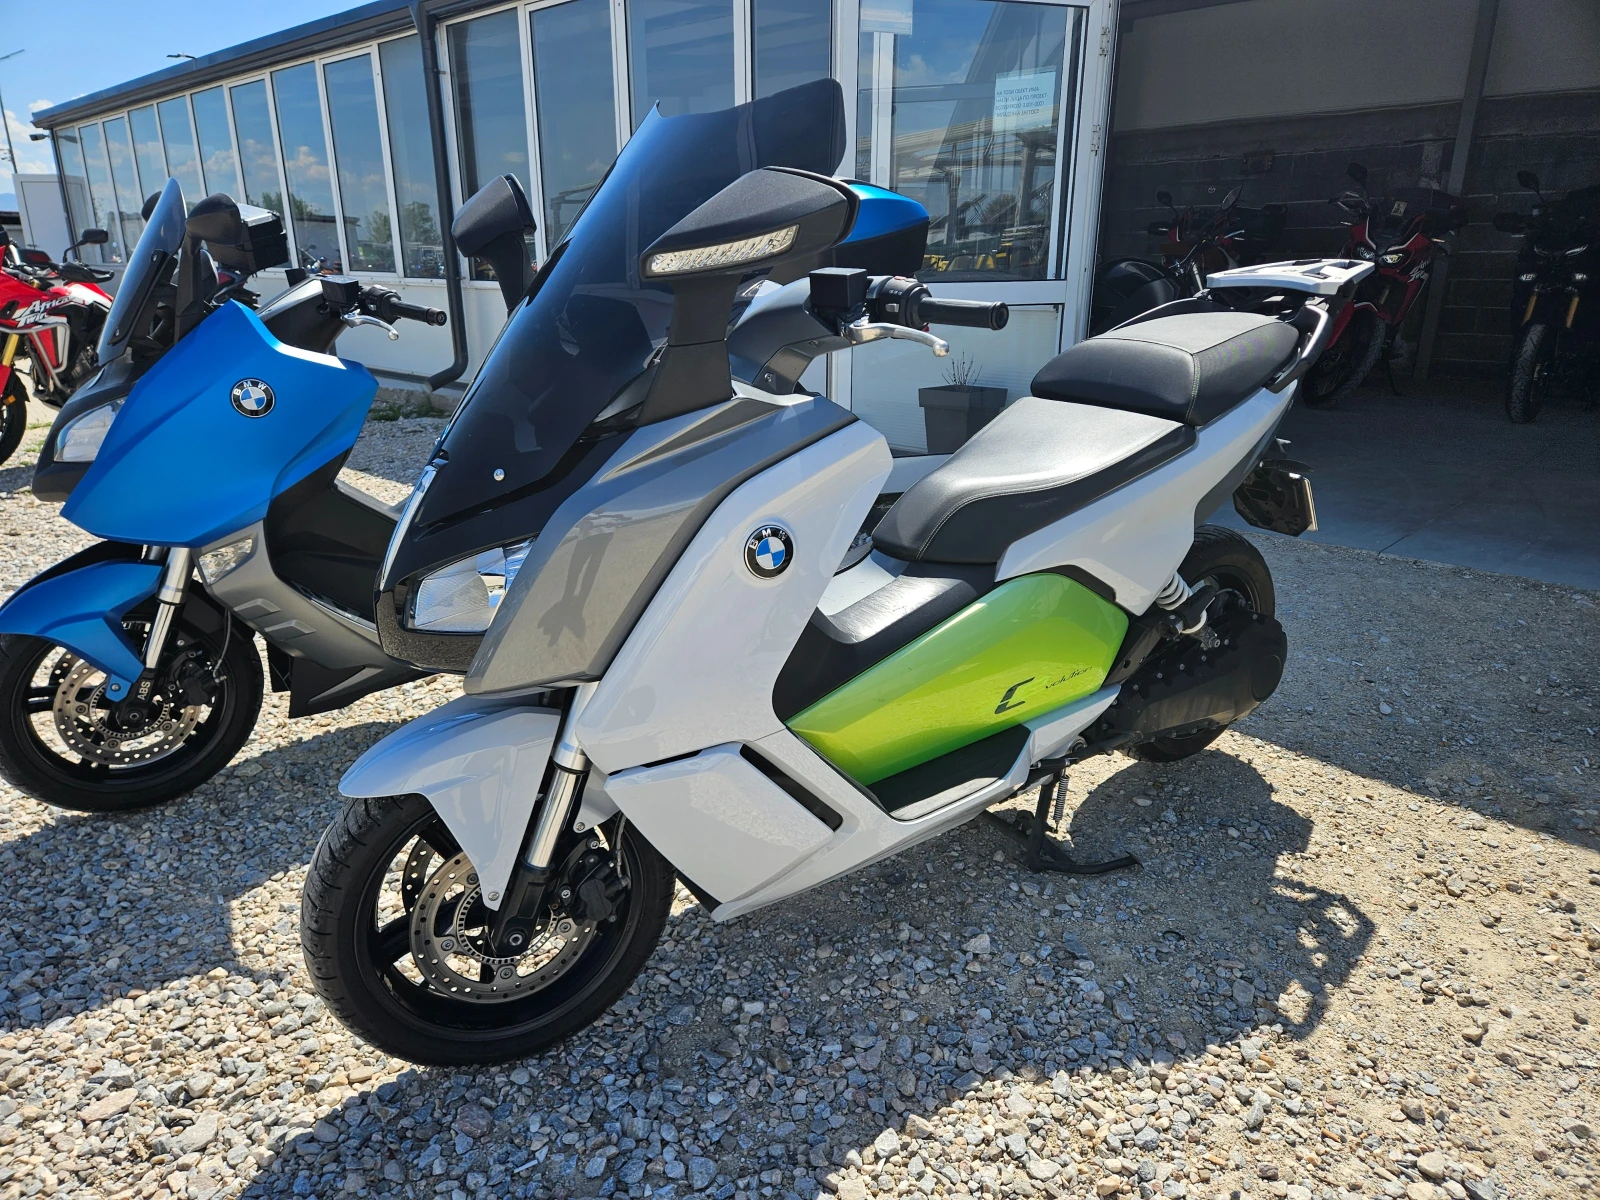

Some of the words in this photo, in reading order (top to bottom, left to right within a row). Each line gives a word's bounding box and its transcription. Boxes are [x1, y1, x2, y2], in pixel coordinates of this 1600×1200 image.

[25, 296, 75, 314] Africa
[15, 312, 48, 328] Twin
[233, 380, 267, 396] BMW
[137, 681, 151, 701] ABS
